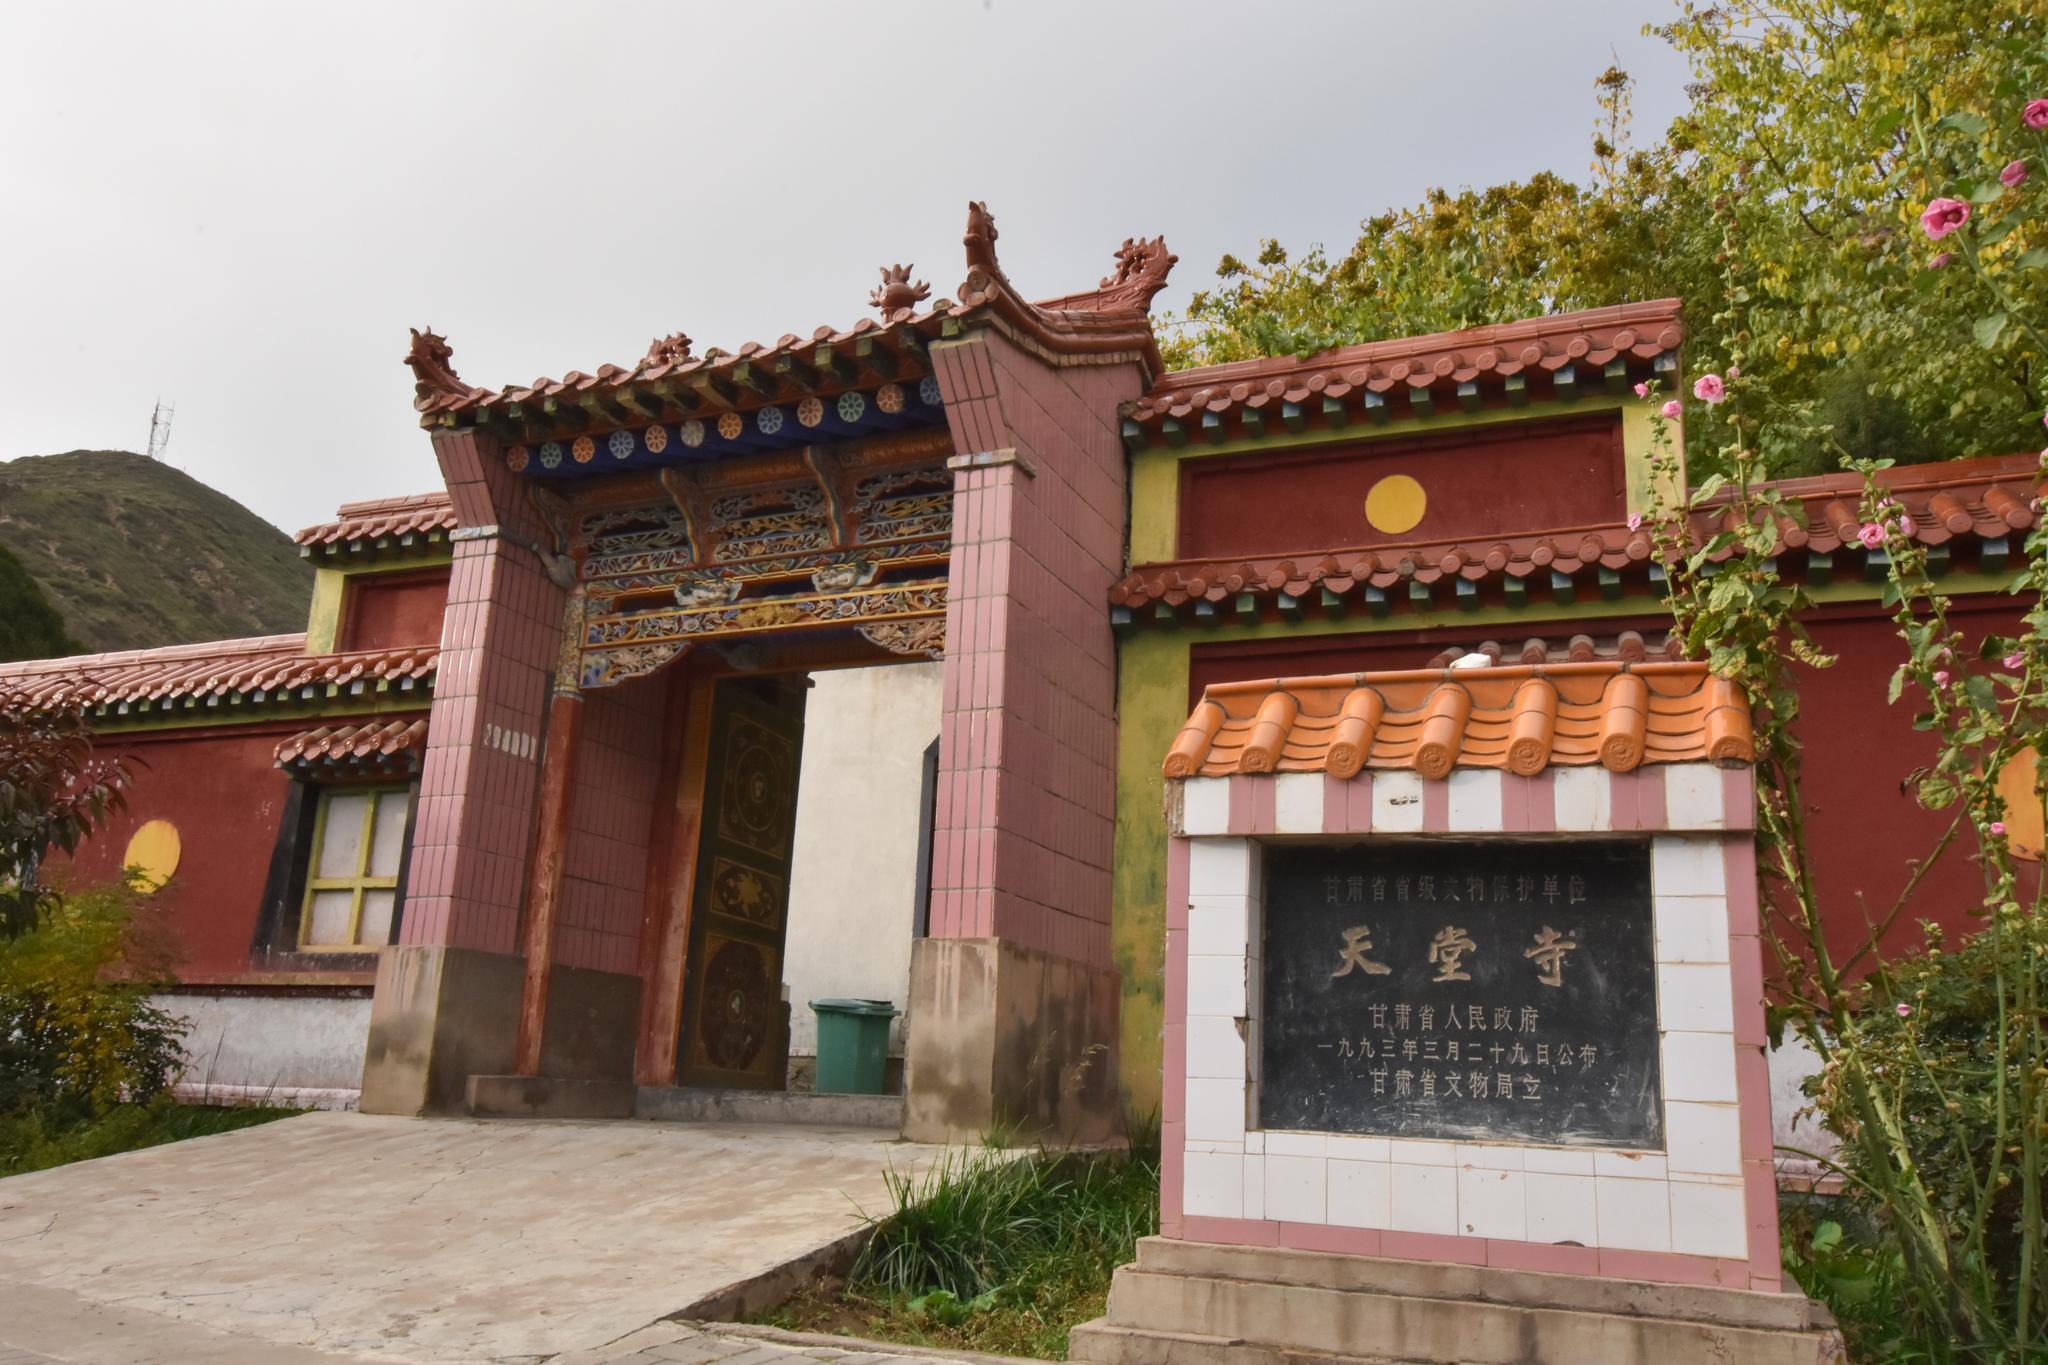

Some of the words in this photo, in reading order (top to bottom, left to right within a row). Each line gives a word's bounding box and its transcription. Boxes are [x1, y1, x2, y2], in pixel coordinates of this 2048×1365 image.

[1323, 875, 1587, 904] 甘肃省省级文物保护单位
[1332, 925, 1577, 988] 天堂寺
[1368, 1003, 1540, 1033] 甘肃省人民政府
[1317, 1037, 1598, 1069] 一九九三年三月二十九日公布
[1371, 1069, 1542, 1100] 甘肃省文物局立
